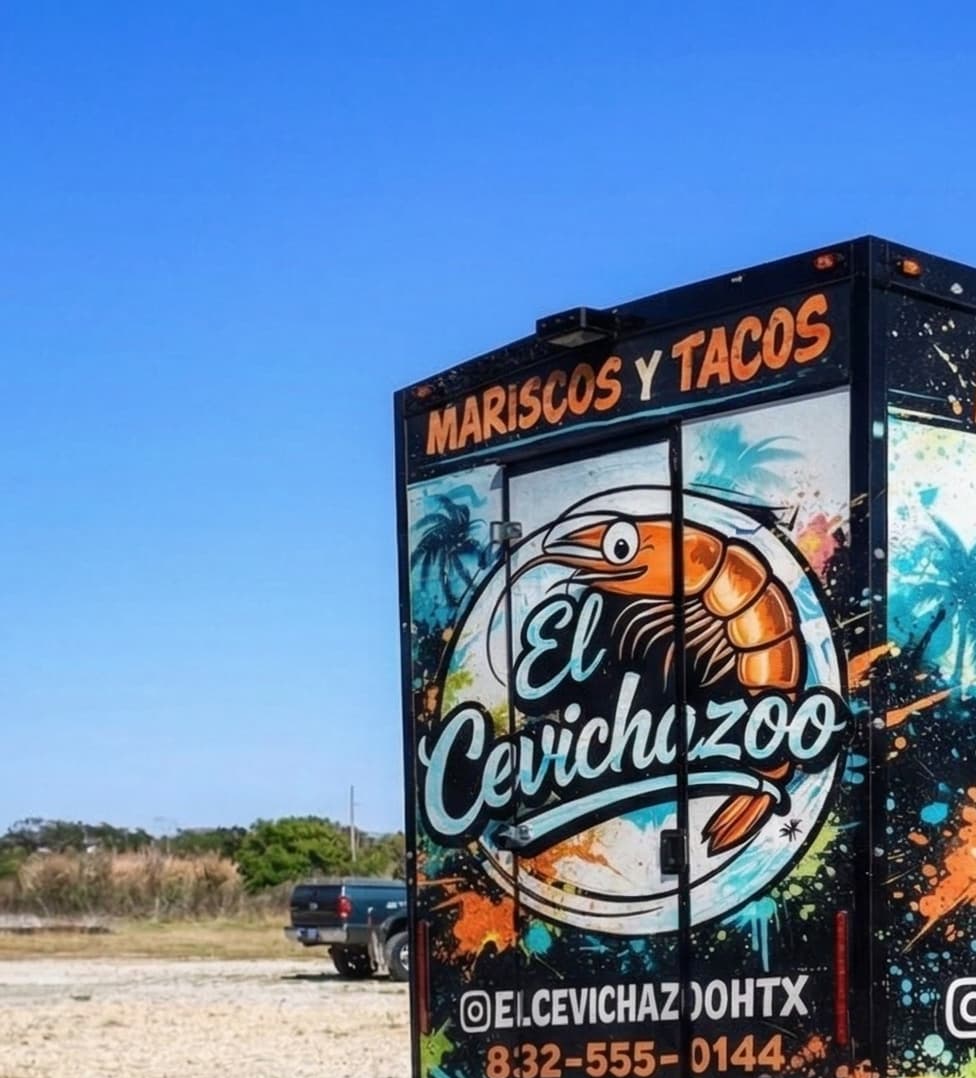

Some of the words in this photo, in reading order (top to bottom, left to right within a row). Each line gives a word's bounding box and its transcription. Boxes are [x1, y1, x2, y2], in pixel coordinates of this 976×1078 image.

[426, 356, 623, 456] MARISCOS
[634, 350, 662, 401] Y
[672, 293, 832, 392] TACOS
[515, 592, 607, 700] El
